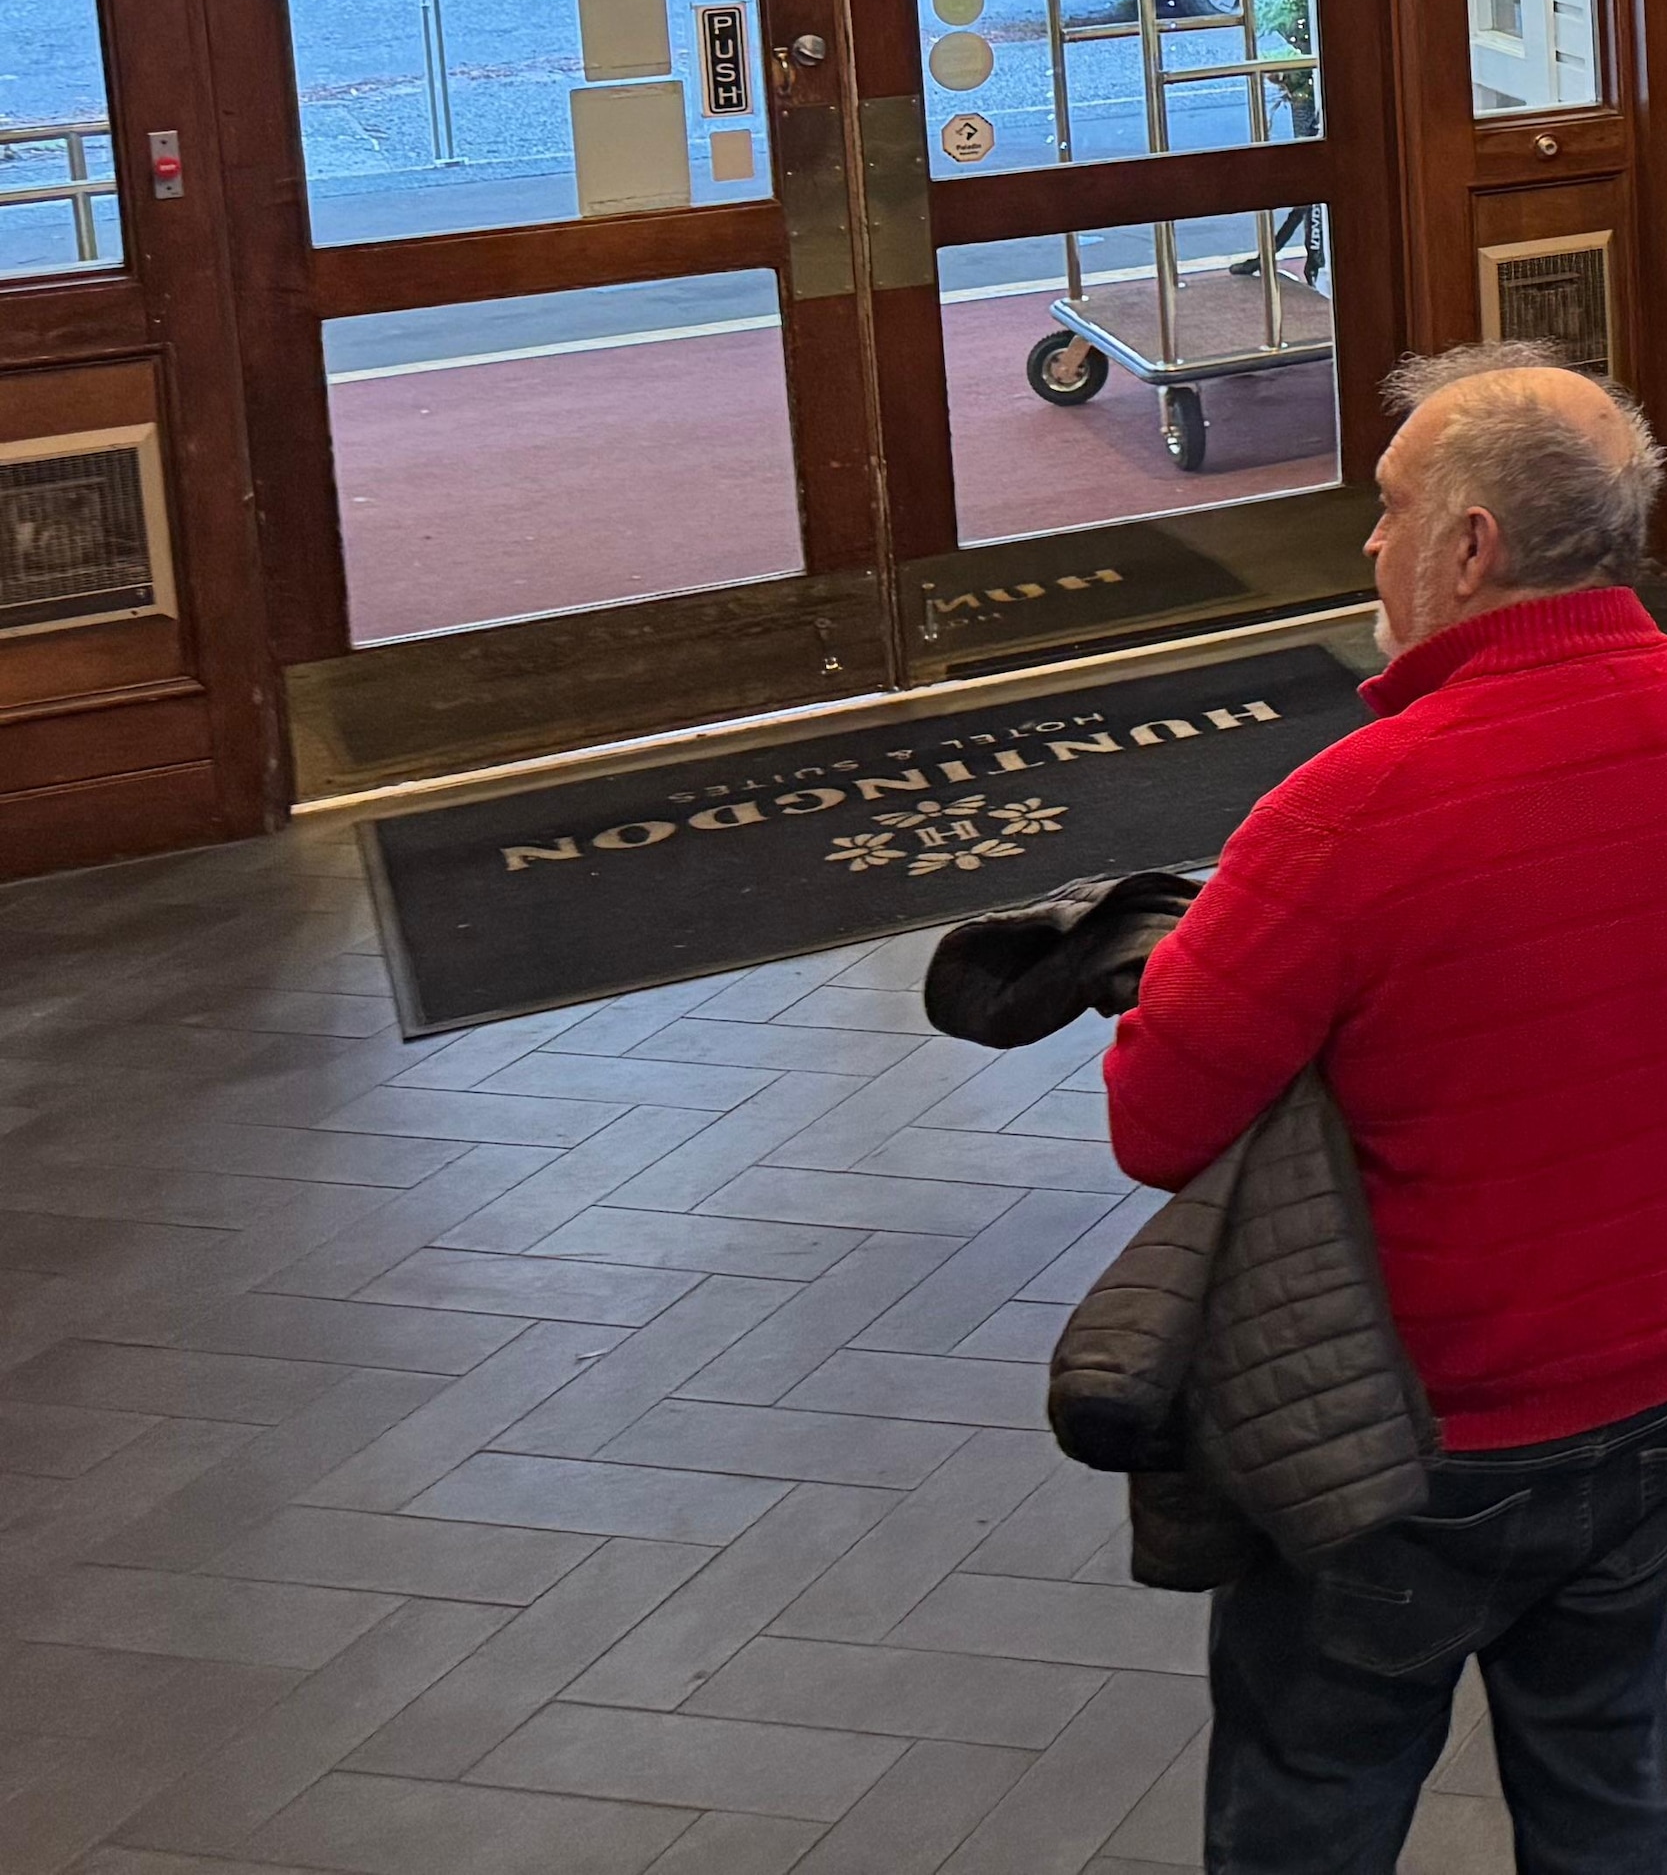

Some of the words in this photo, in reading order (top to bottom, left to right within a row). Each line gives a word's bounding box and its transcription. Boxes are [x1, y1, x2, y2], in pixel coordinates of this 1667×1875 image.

[714, 16, 738, 106] PUSH
[941, 712, 1104, 751] HOTEL
[884, 750, 913, 762] &
[500, 699, 1282, 872] HUNTINGDON
[668, 759, 859, 804] SUITES
[917, 819, 981, 851] H
